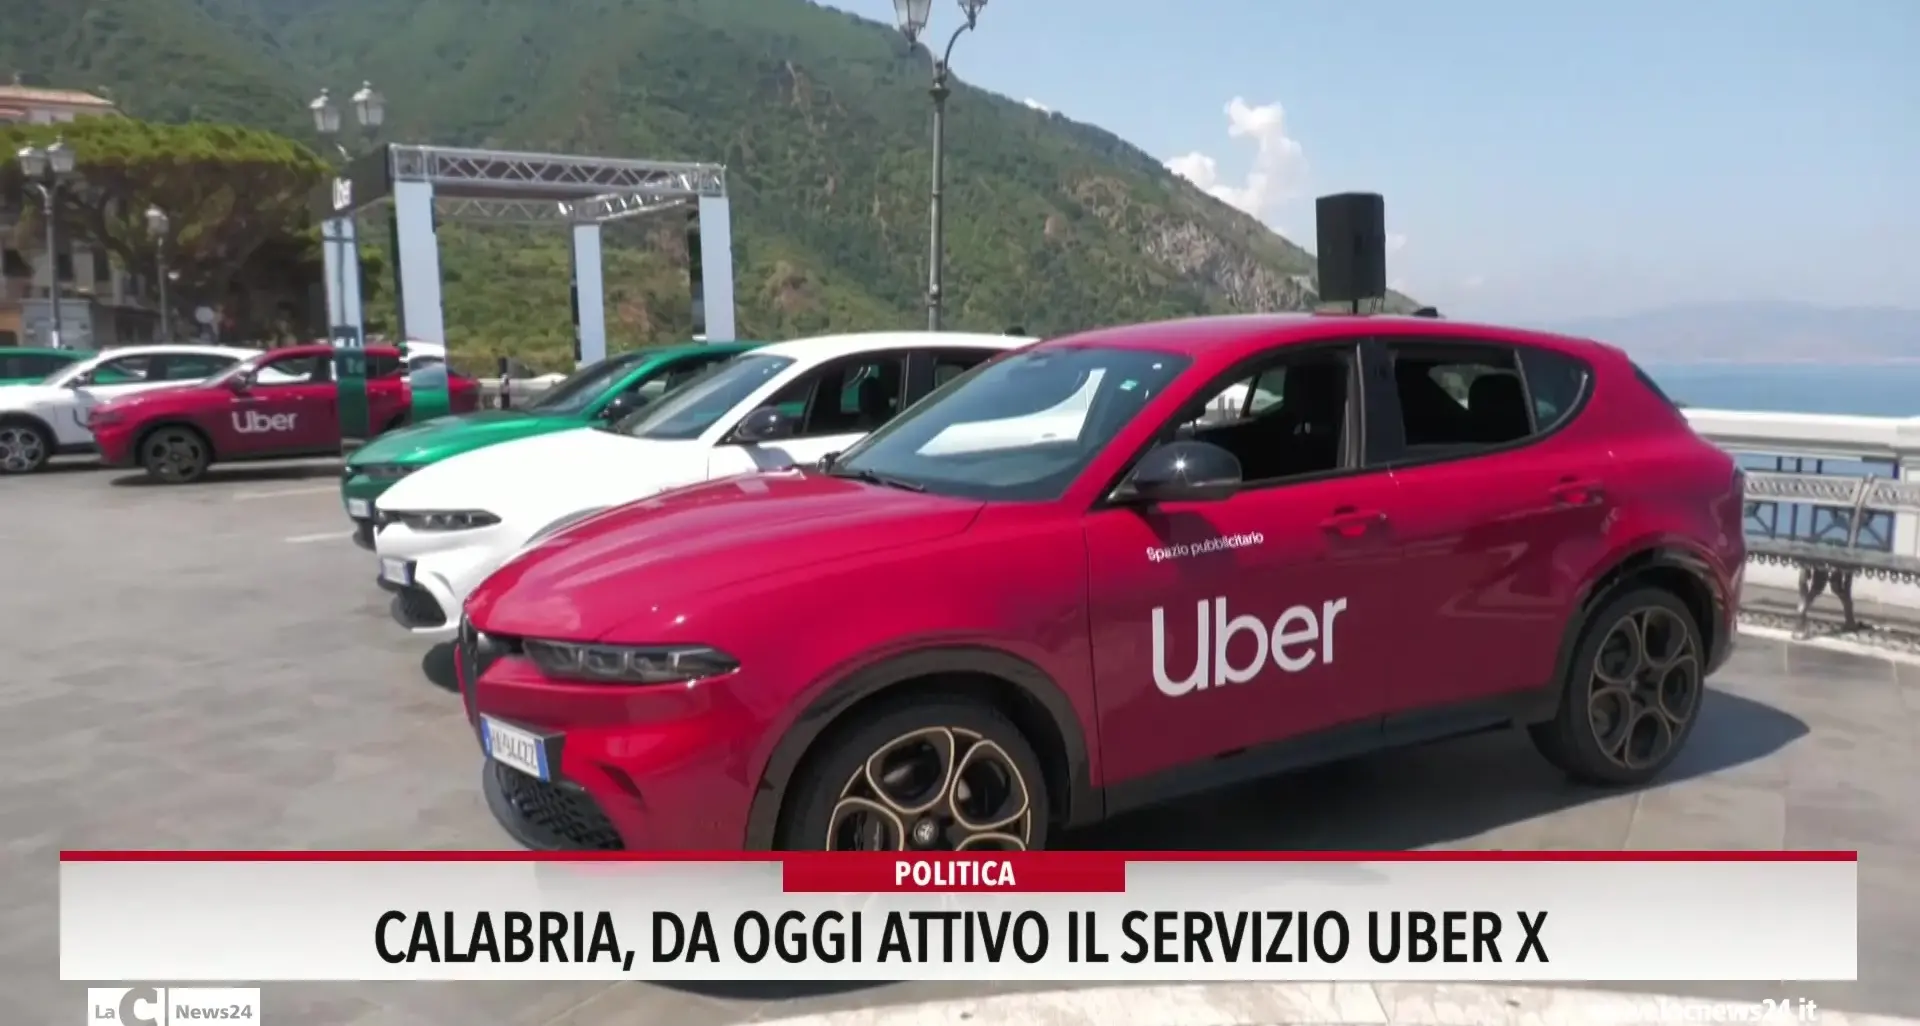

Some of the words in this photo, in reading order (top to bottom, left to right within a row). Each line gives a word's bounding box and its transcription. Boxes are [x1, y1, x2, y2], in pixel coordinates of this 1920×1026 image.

[231, 410, 299, 433] Uber
[1146, 543, 1189, 562] Spazio
[1190, 531, 1264, 557] pubblicitario
[1152, 596, 1347, 697] Uber
